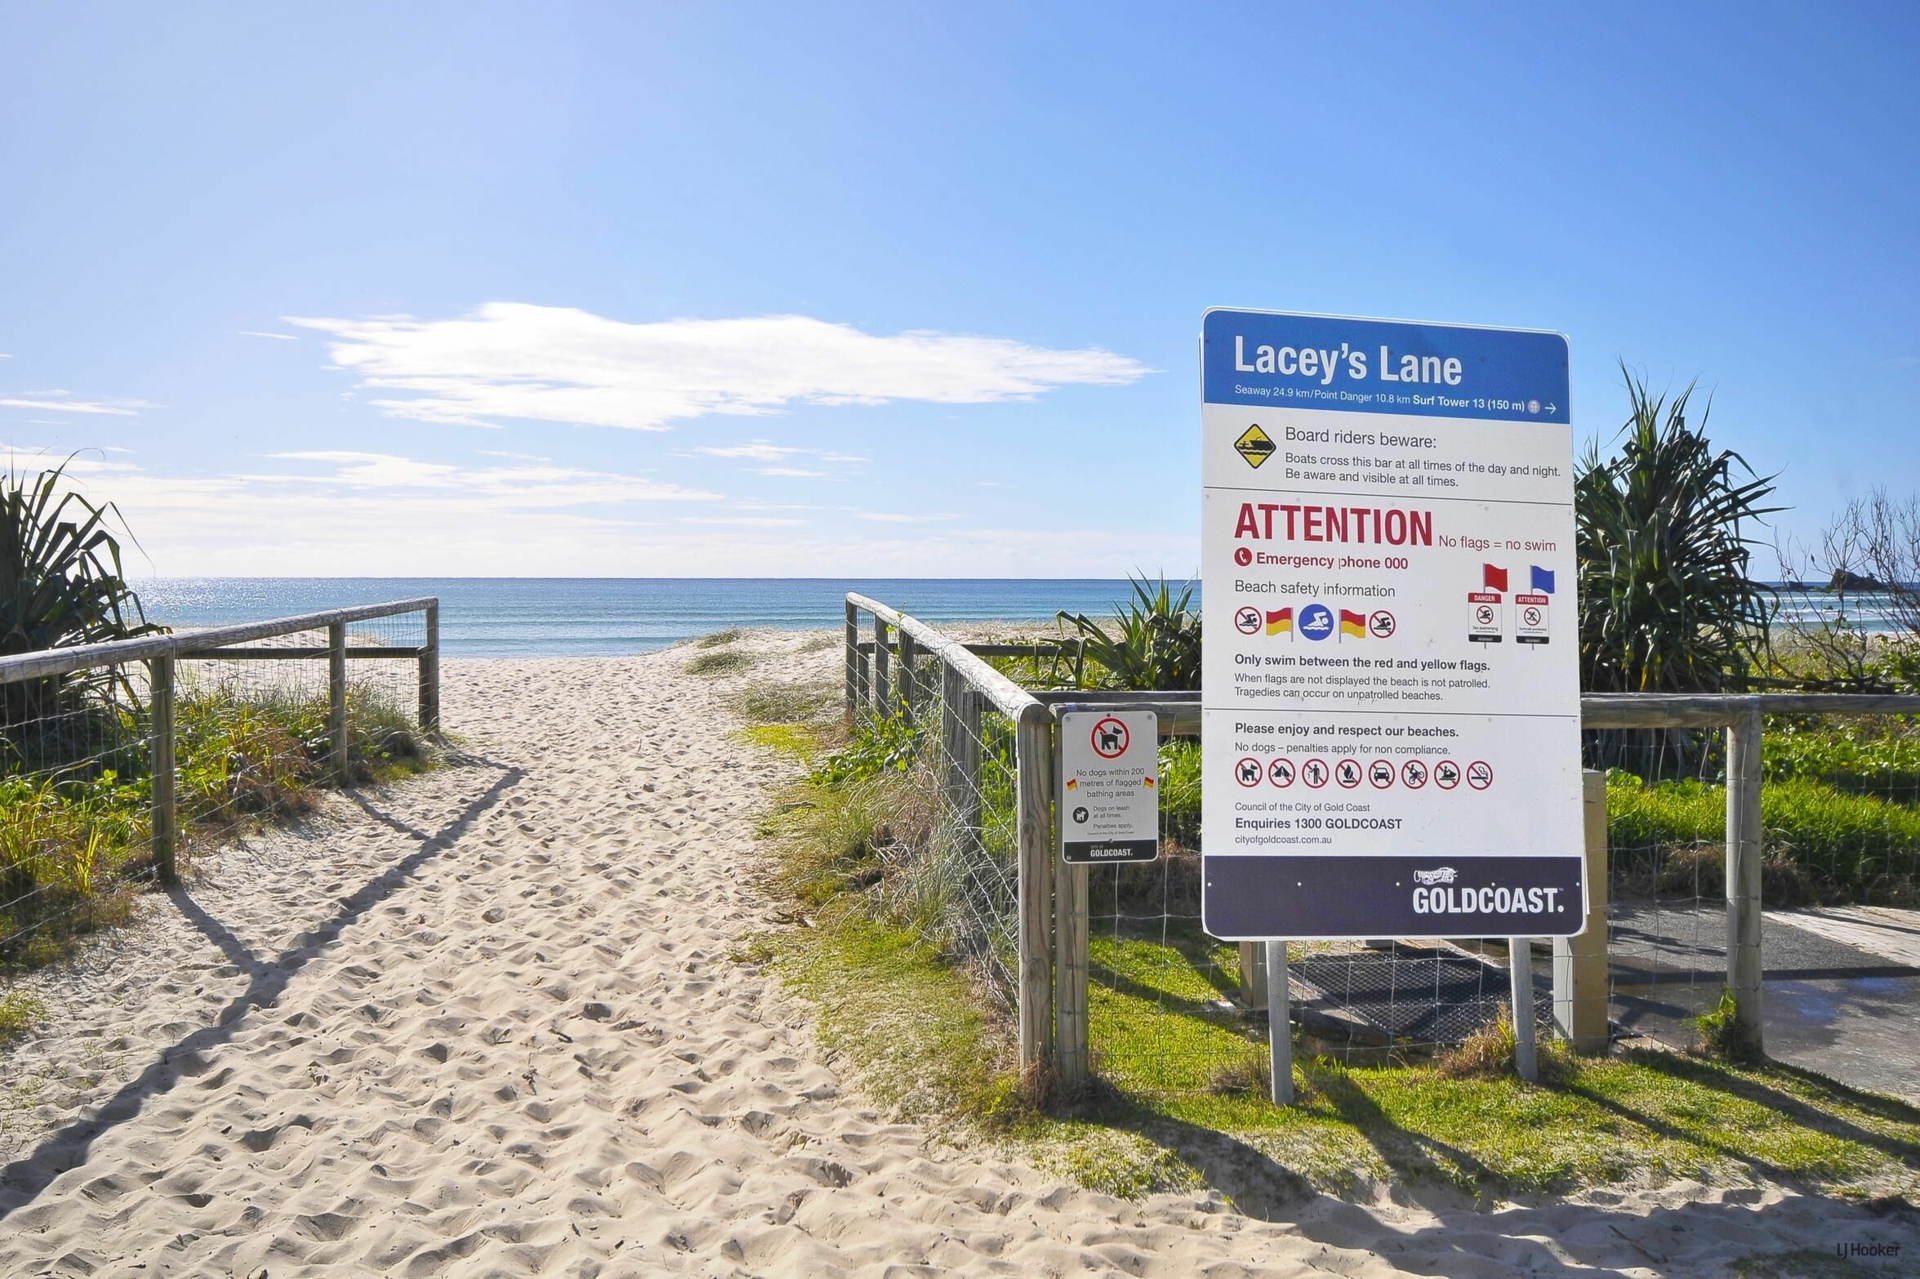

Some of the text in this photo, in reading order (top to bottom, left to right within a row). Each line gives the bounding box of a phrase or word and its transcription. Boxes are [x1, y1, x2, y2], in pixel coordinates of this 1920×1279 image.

[1235, 335, 1462, 386] Lacey's Lane
[1235, 384, 1271, 398] Seaway
[1273, 387, 1294, 397] 24.9
[1340, 391, 1372, 404] Danger
[1376, 394, 1394, 403] 10.8
[1396, 395, 1410, 404] km
[1412, 395, 1435, 404] Surf
[1437, 396, 1470, 408] Tower
[1472, 398, 1485, 408] 13
[1487, 399, 1510, 411] (150
[1512, 401, 1525, 412] m)
[1286, 426, 1436, 448] Board riders beware:
[1285, 452, 1561, 479] Boats cross this bar at all times of the day and night.
[1286, 468, 1458, 487] Be aware and visible at all times.
[1234, 503, 1432, 546] ATTENTION
[1439, 535, 1457, 548] No
[1460, 535, 1490, 552] flags
[1506, 540, 1521, 550] no
[1524, 539, 1556, 552] swim
[1256, 552, 1334, 569] Emergency
[1384, 557, 1408, 570] 000
[1235, 579, 1395, 598] Beach safety information
[1234, 654, 1490, 673] Only swim between the red and yellow flags.
[1234, 673, 1490, 689] When flags are not displayed the beach is not patrolled.
[1234, 686, 1443, 702] Tragedies can occur on unpatrolled beaches.
[1235, 722, 1459, 738] Please enjoy and respect our beaches.
[1235, 742, 1249, 752] No
[1252, 742, 1276, 754] dogs
[1286, 743, 1329, 754] penalties
[1331, 744, 1357, 756] apply
[1359, 744, 1372, 754] for
[1374, 746, 1392, 754] non
[1394, 745, 1450, 756] compliance.
[1076, 769, 1087, 777] No
[1088, 769, 1107, 778] dogs
[1108, 768, 1129, 776] within
[1114, 779, 1141, 788] flagged
[1086, 790, 1113, 799] bathing
[1234, 802, 1370, 813] Council of the City of Gold Coast
[1236, 818, 1402, 831] Enquiries 1300 GOLDCOAST
[1234, 835, 1332, 846] cityofgoldcoast.com.au
